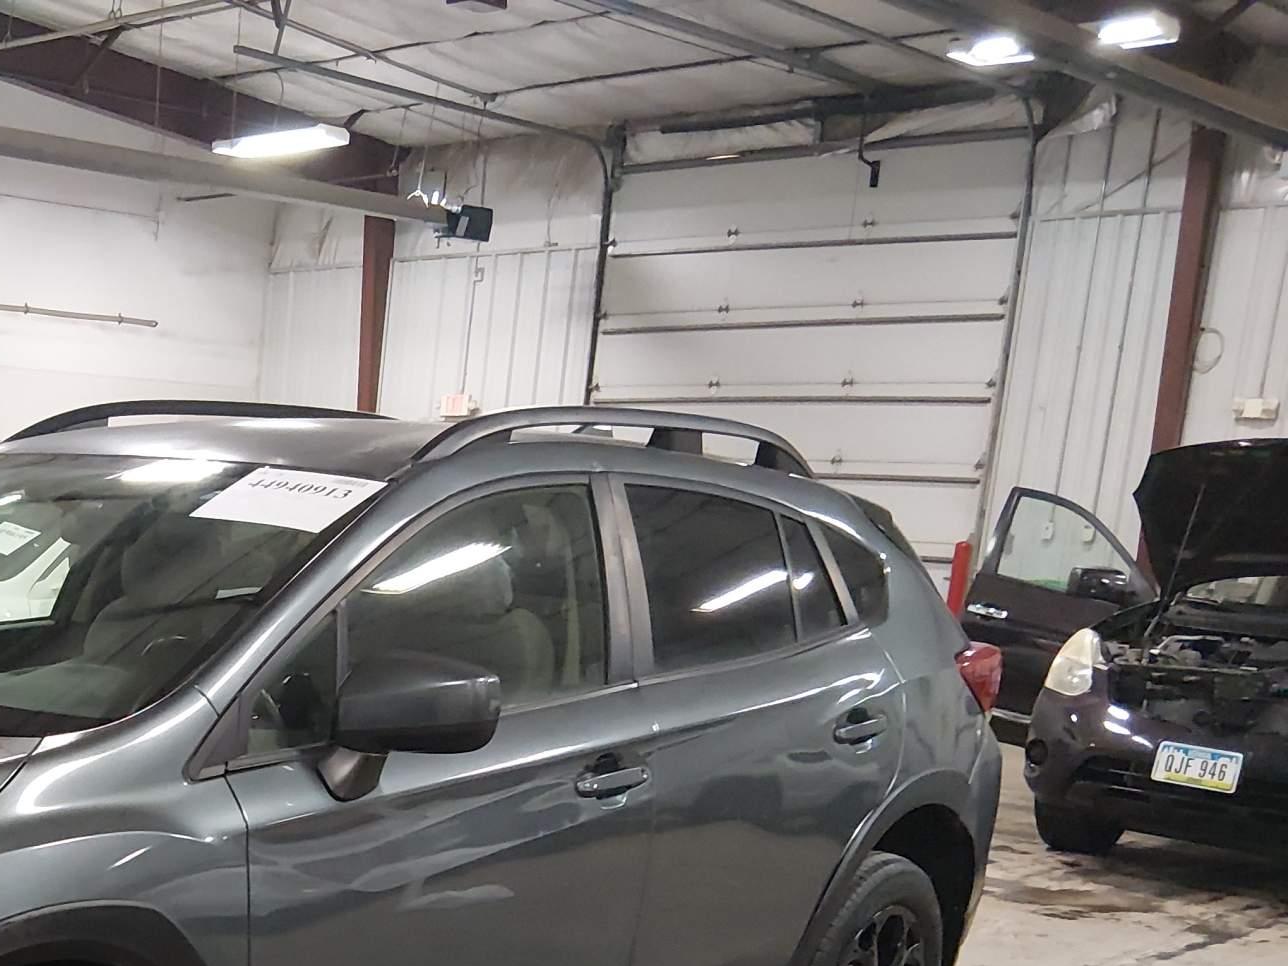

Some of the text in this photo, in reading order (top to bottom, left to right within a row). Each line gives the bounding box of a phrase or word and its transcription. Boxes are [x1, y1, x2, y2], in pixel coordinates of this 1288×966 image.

[248, 478, 353, 499] 44940913
[1164, 754, 1195, 775] QJF
[1198, 760, 1228, 781] 946
